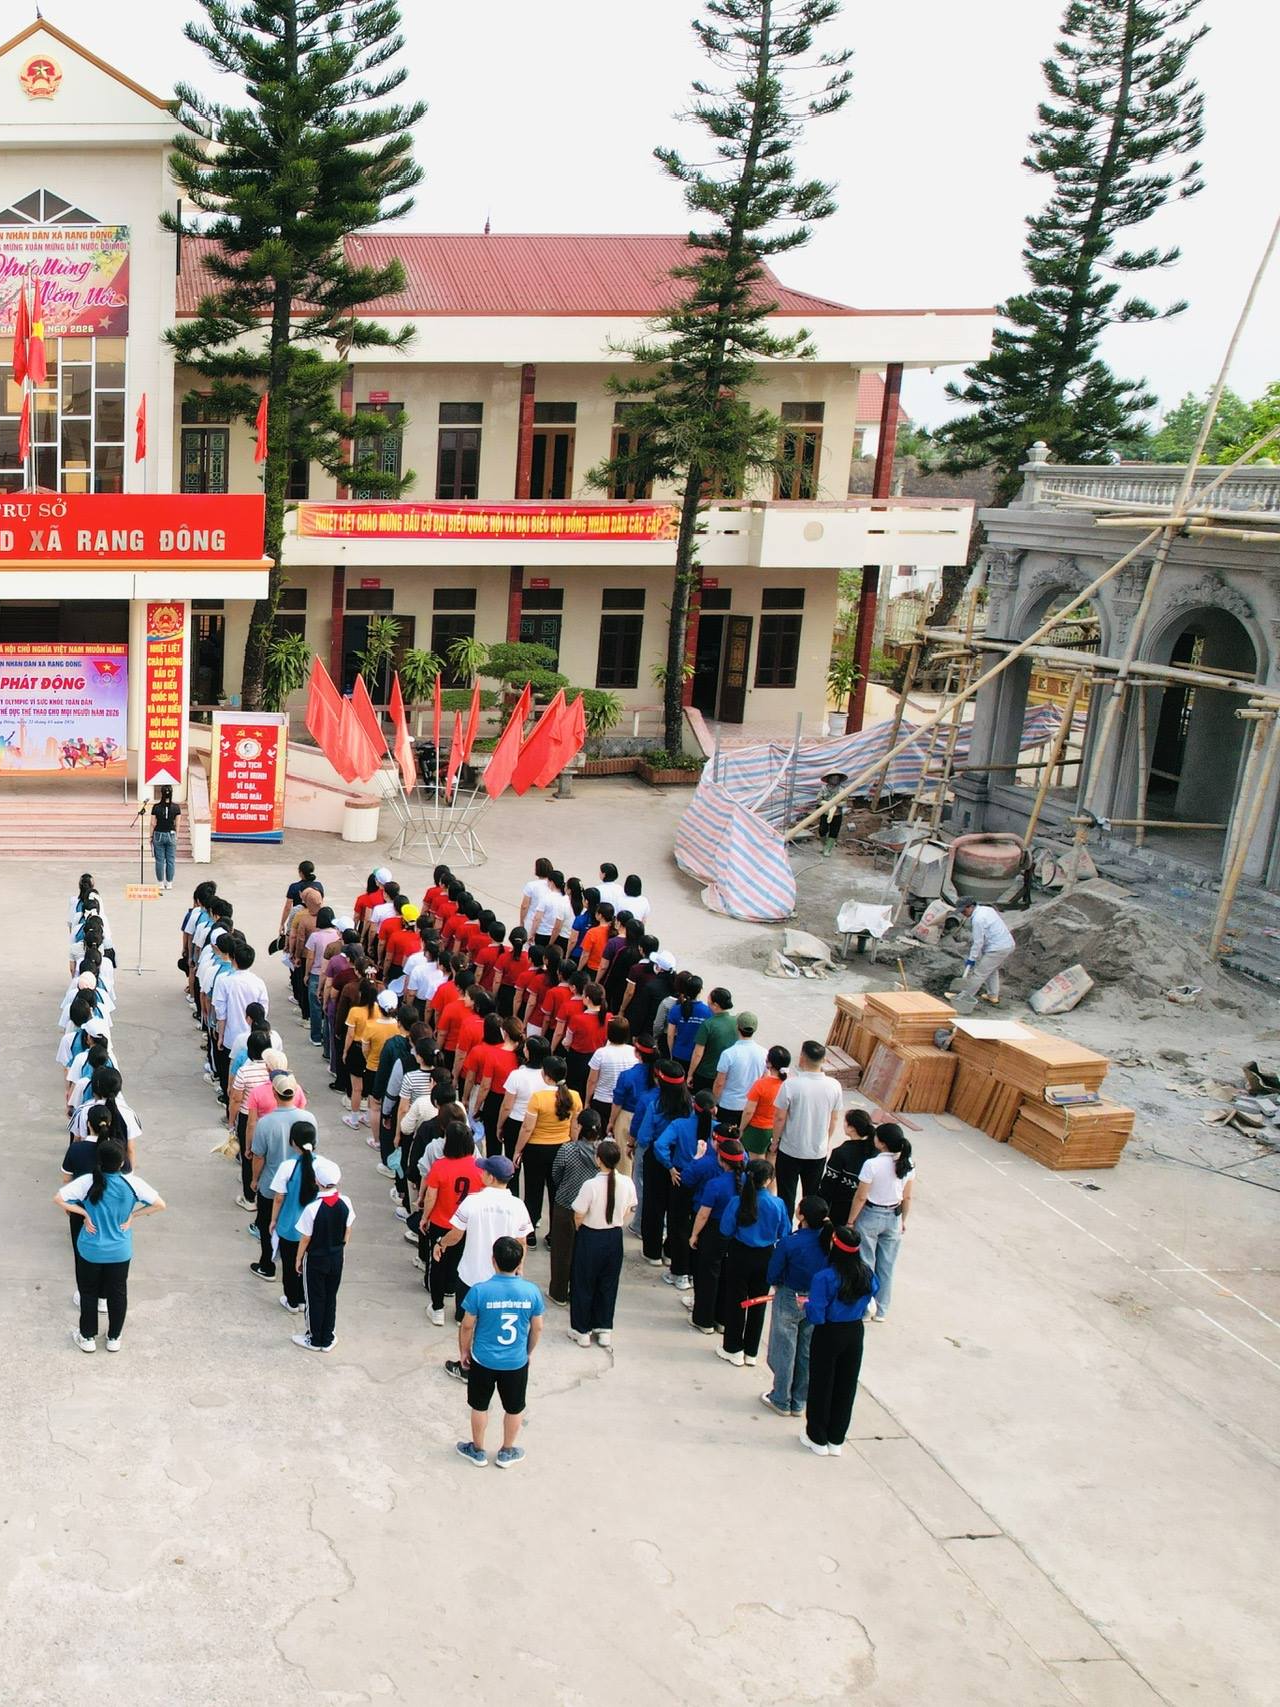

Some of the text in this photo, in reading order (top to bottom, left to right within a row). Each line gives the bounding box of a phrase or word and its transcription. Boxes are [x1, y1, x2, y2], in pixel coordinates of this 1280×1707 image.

[32, 230, 49, 240] DÂN
[52, 230, 62, 240] XÃ
[70, 325, 94, 333] 2026
[38, 498, 68, 518] SỞ
[357, 510, 377, 531] CHÀO
[629, 512, 645, 533] CÁC
[29, 525, 63, 552] XÃ
[77, 530, 145, 556] RẠNG
[159, 523, 226, 552] ĐÔNG
[0, 674, 38, 690] PHÁT
[40, 674, 86, 693] ĐỘNG
[497, 1314, 520, 1345] 3
